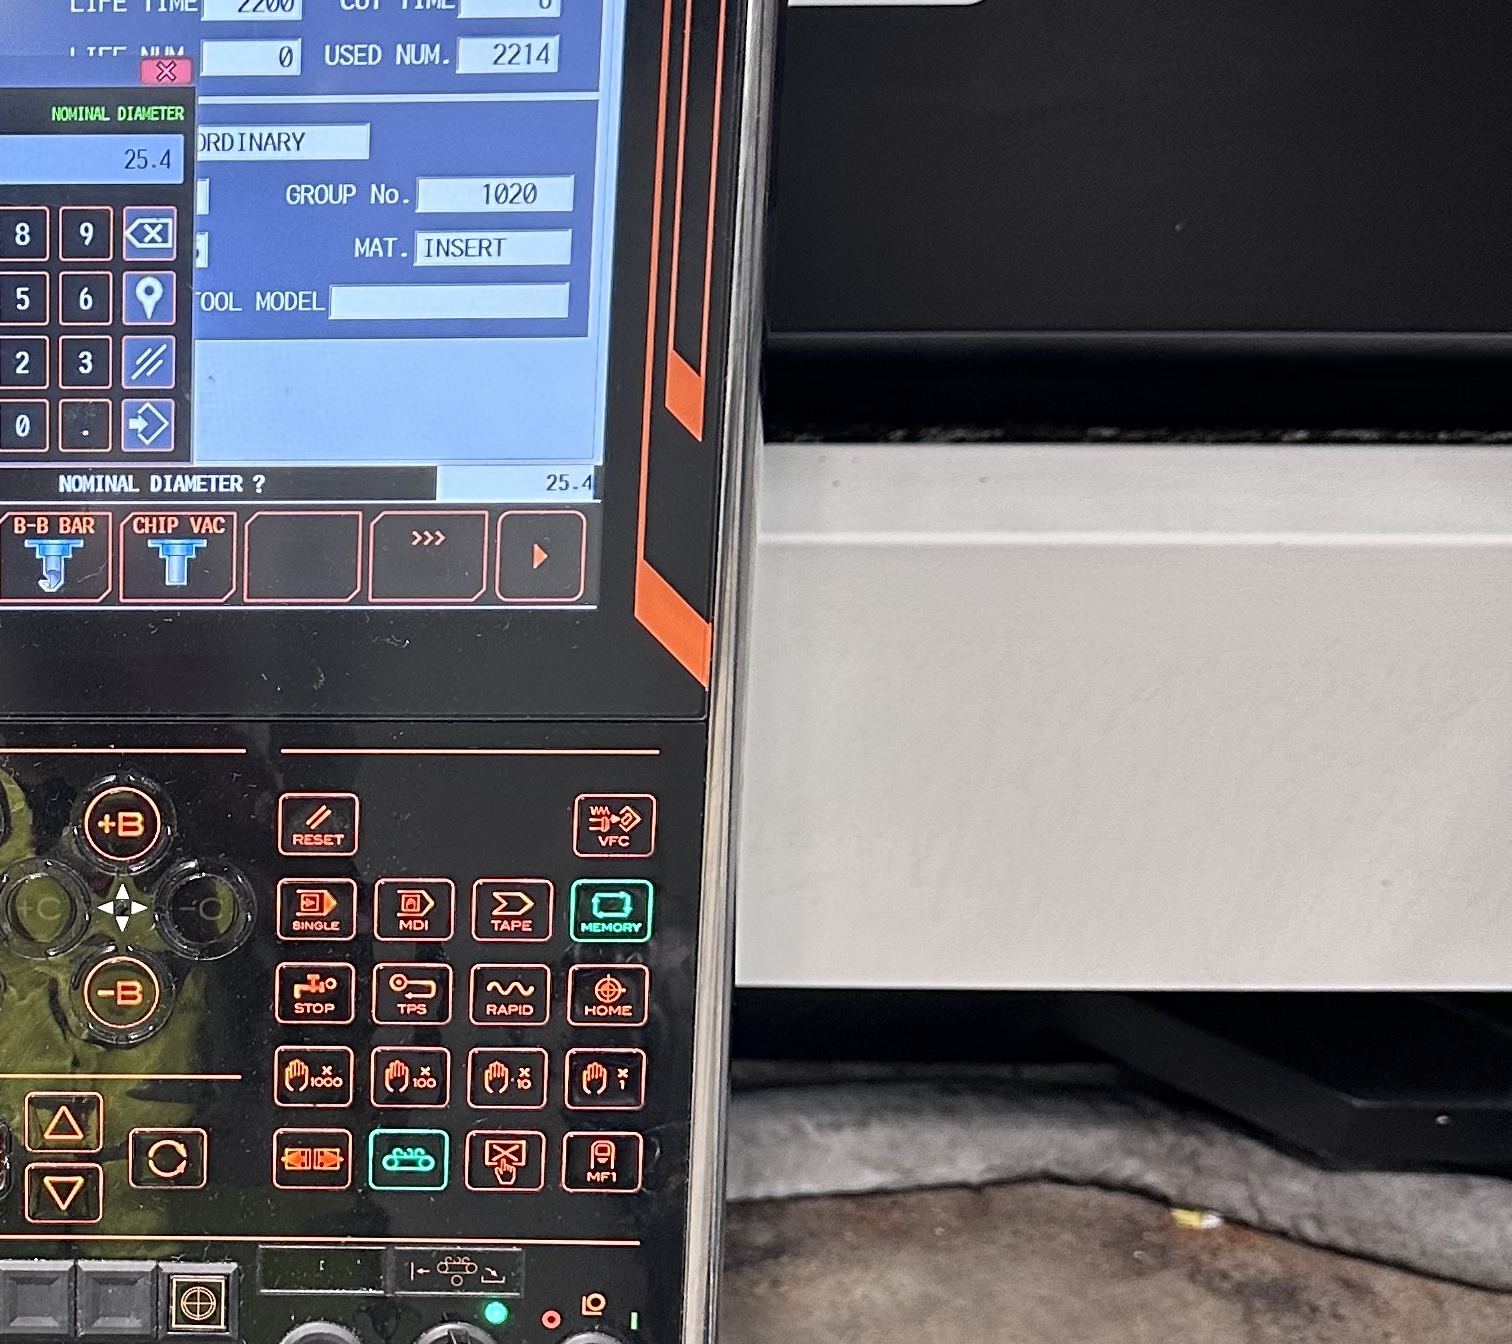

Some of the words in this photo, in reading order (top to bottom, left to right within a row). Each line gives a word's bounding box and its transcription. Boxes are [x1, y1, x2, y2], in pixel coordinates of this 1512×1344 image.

[324, 44, 382, 67] USED
[396, 43, 451, 66] NUM.
[493, 43, 550, 66] 2214
[51, 107, 110, 122] NOMINAL
[117, 107, 184, 121] DIAMETER
[125, 149, 171, 170] 25.4
[286, 184, 356, 206] GROUP
[370, 184, 410, 205] No.
[484, 183, 537, 205] 1020
[354, 237, 408, 259] MAT.
[425, 237, 508, 258] INSERT
[195, 291, 242, 312] OOL
[255, 290, 326, 312] MODEL
[59, 475, 139, 493] NOMINAL
[150, 475, 243, 493] DIAMETER
[546, 473, 593, 492] 25.4
[14, 516, 49, 535] B-B
[59, 516, 95, 535] BAR
[133, 516, 179, 534] CHIP
[191, 516, 226, 534] VAC
[98, 811, 145, 837] +B
[292, 833, 344, 846] RESET
[597, 835, 630, 847] VFC
[292, 921, 340, 931] SINGLE
[399, 920, 429, 931] MDI
[491, 920, 532, 932] TAPE
[581, 922, 642, 933] MEMORY
[294, 1003, 335, 1014] STOP
[397, 1003, 427, 1015] TPS
[486, 1004, 534, 1016] RAPID
[585, 1005, 632, 1017] HOME
[311, 1077, 343, 1087] 1000
[413, 1078, 437, 1088] 100
[517, 1079, 532, 1089] 10
[587, 1171, 616, 1183] MF1
